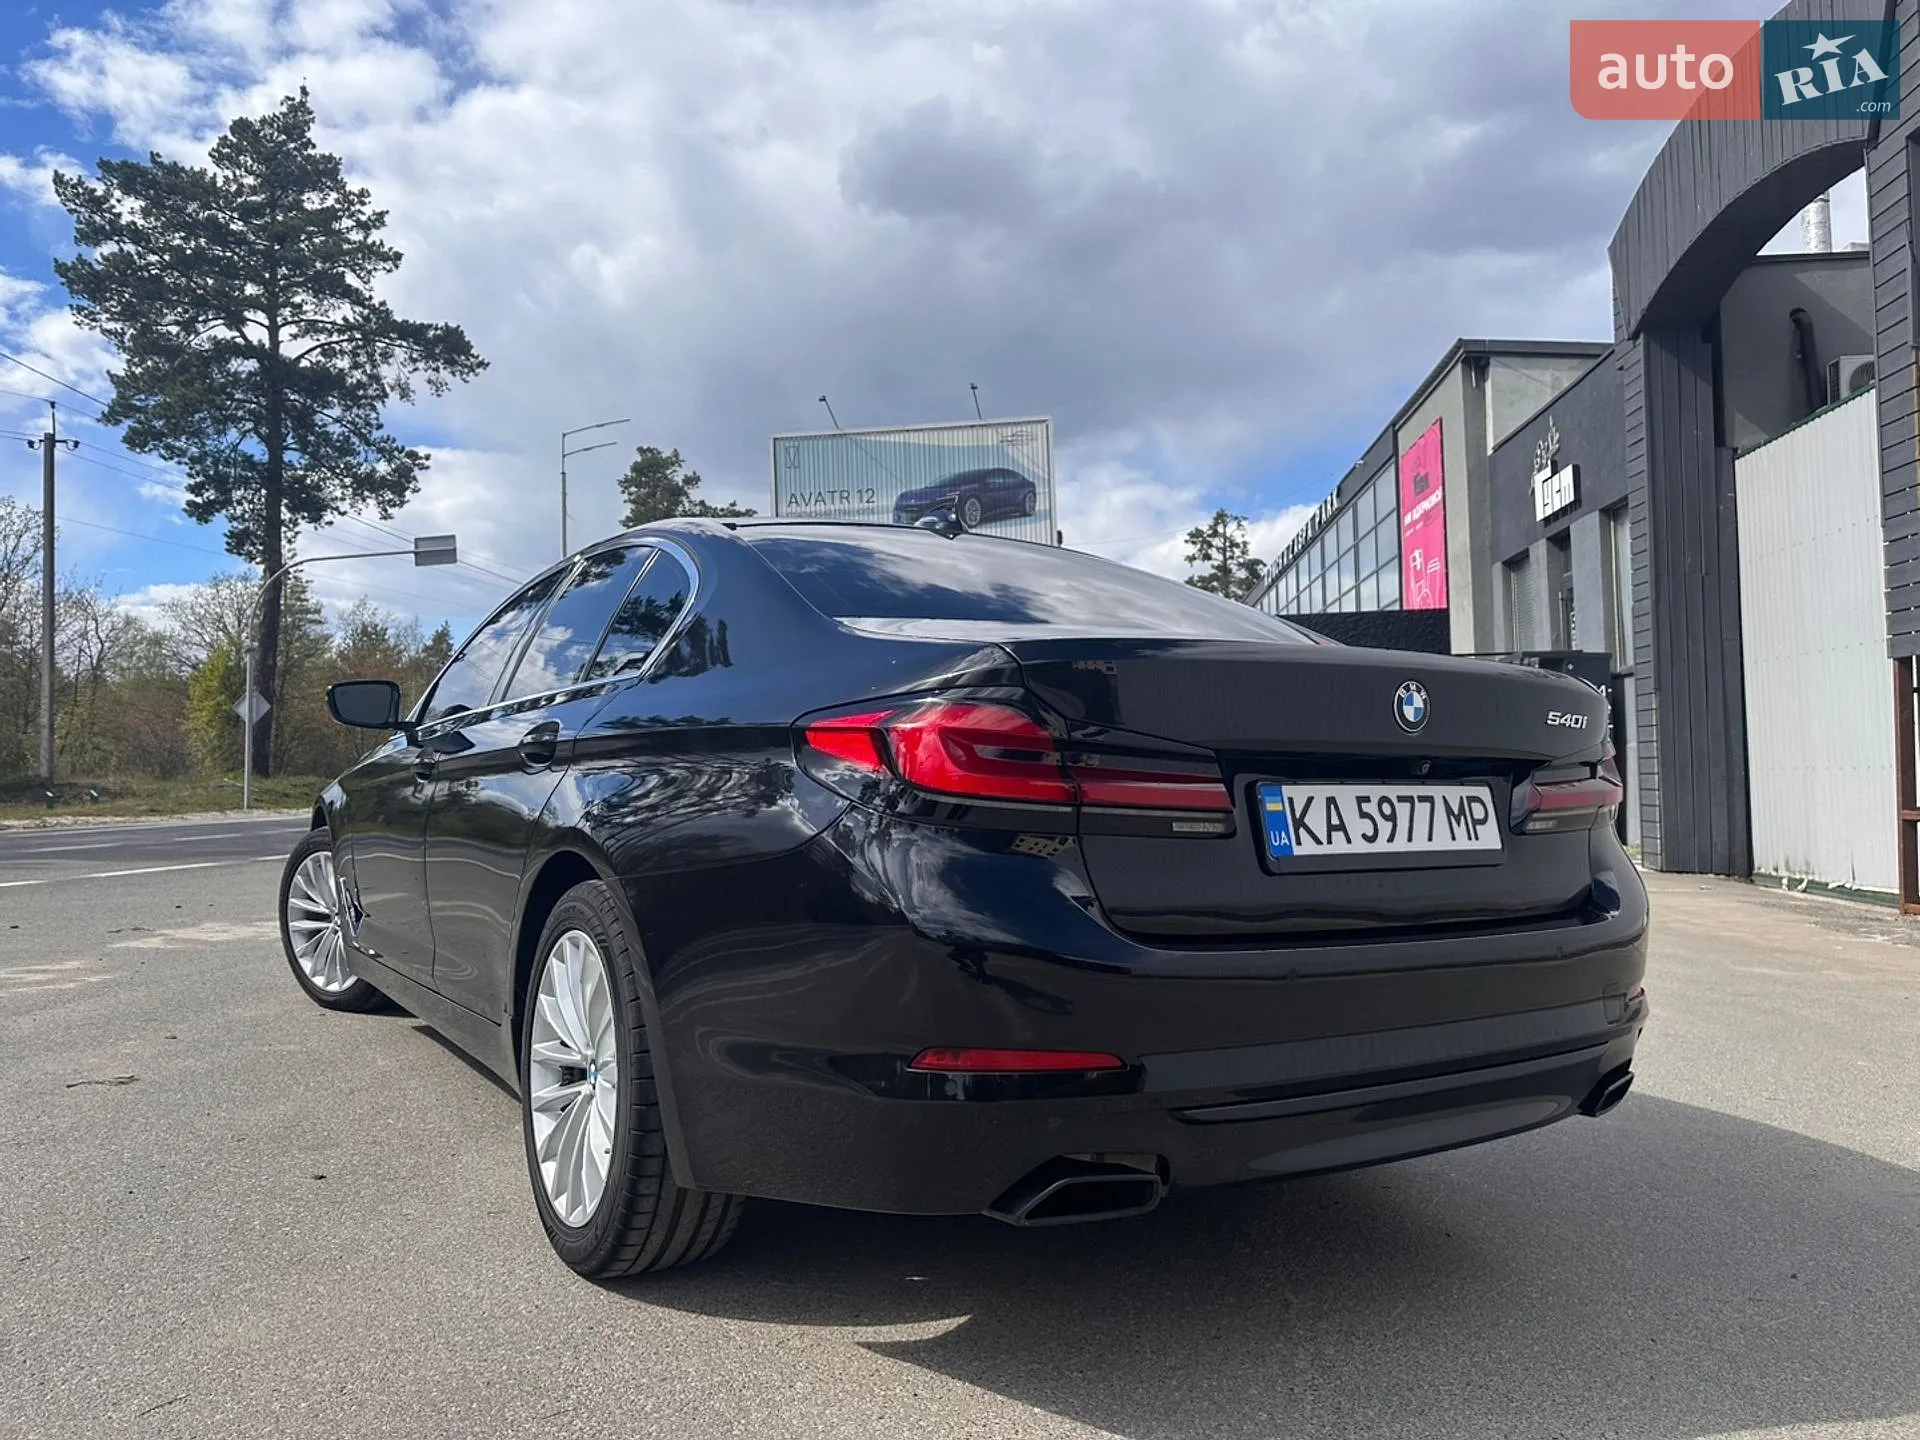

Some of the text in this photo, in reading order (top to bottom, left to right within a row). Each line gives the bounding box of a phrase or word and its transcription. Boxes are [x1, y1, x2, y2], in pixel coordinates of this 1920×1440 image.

[787, 487, 875, 507] AVATR 12
[1398, 682, 1428, 699] BMW
[1546, 710, 1588, 730] 540i
[1287, 794, 1490, 846] KA 5977 MP
[1270, 831, 1290, 848] UA
